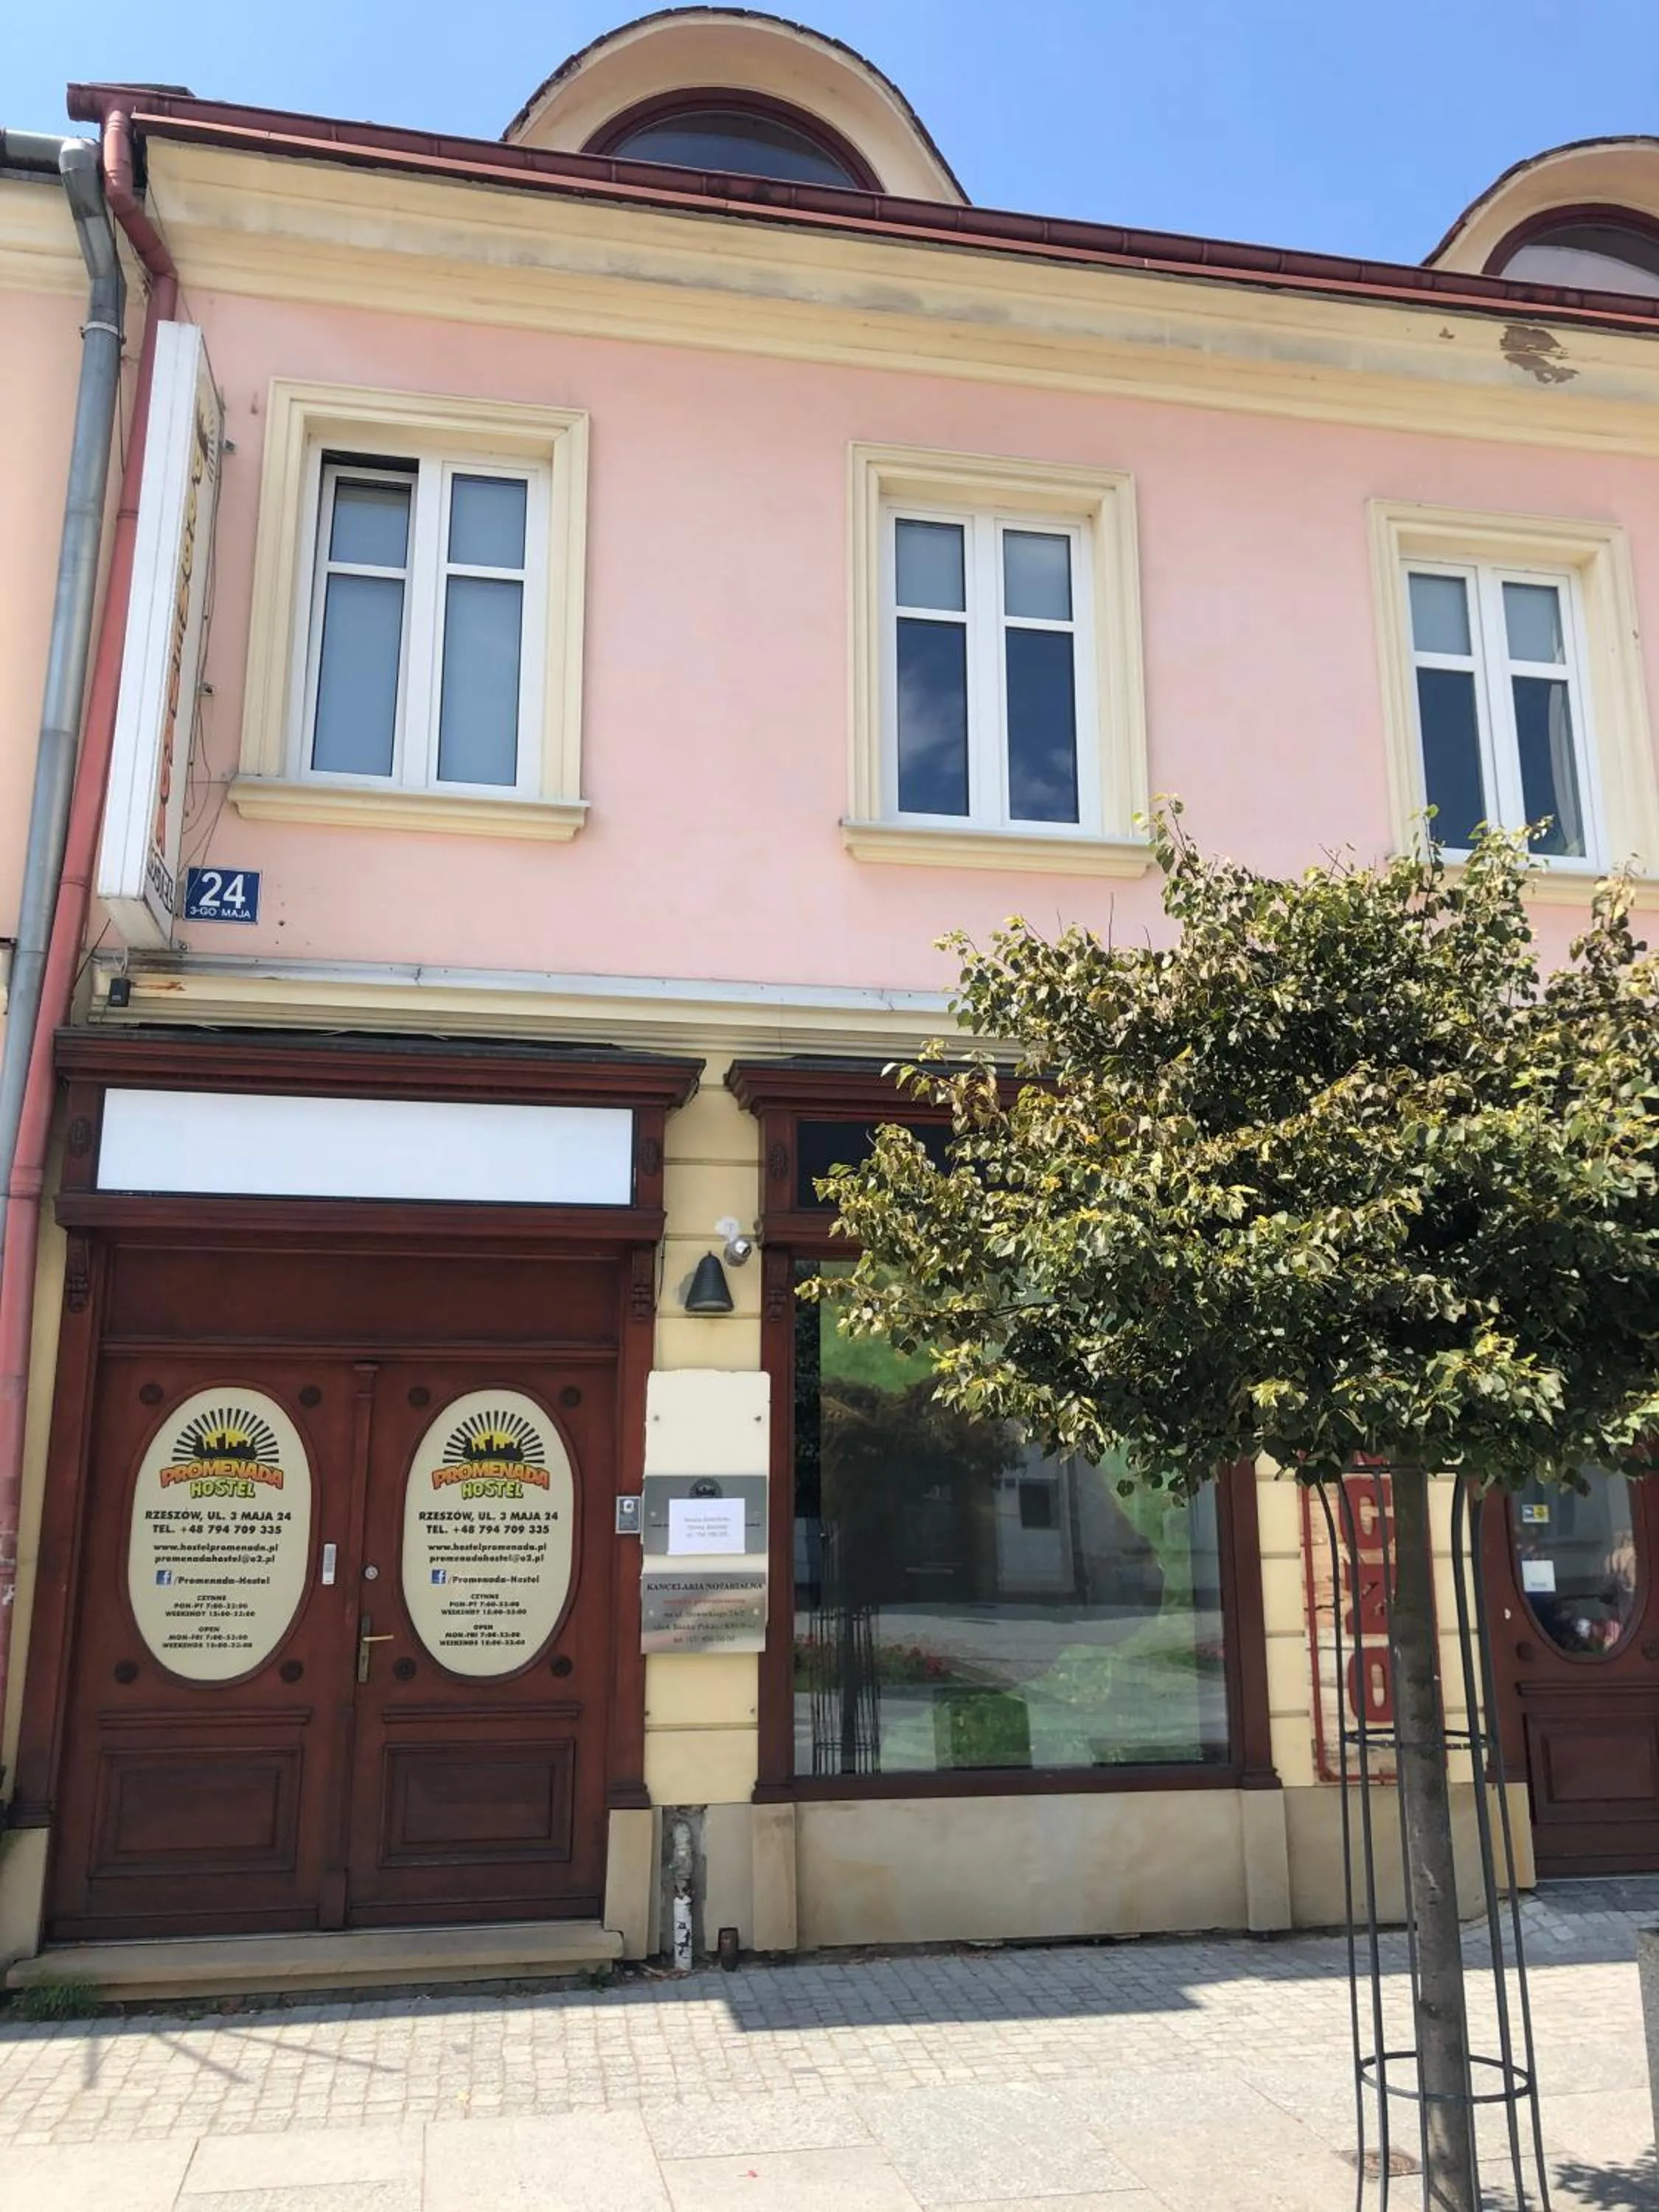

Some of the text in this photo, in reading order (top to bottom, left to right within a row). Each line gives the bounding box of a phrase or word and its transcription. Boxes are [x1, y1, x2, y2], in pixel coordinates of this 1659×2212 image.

[199, 871, 246, 908] 24
[189, 906, 251, 918] 3-GO MAJA
[160, 1458, 284, 1489] PROMENADA
[432, 1460, 551, 1490] PROMENADA
[189, 1479, 257, 1498] HOSTEL
[462, 1481, 524, 1500] HOSTEL
[145, 1508, 291, 1522] RZESZÓW, UL. 3 MAJA 24
[419, 1509, 558, 1522] RZESZÓW, UL. 3 MAJA 24
[153, 1525, 282, 1534] TEL. +48 794 709 335
[426, 1525, 549, 1534] TEL. +48 794 709 335
[153, 1543, 279, 1553] www.hostelpromenada.pl
[428, 1543, 546, 1552] www.hostelpromenada.pl
[154, 1554, 275, 1565] promenadahostel@o2.pl
[429, 1554, 544, 1563] promenadahostel@o2.pl
[647, 1582, 763, 1591] KANCELARIA NOTARIALNA
